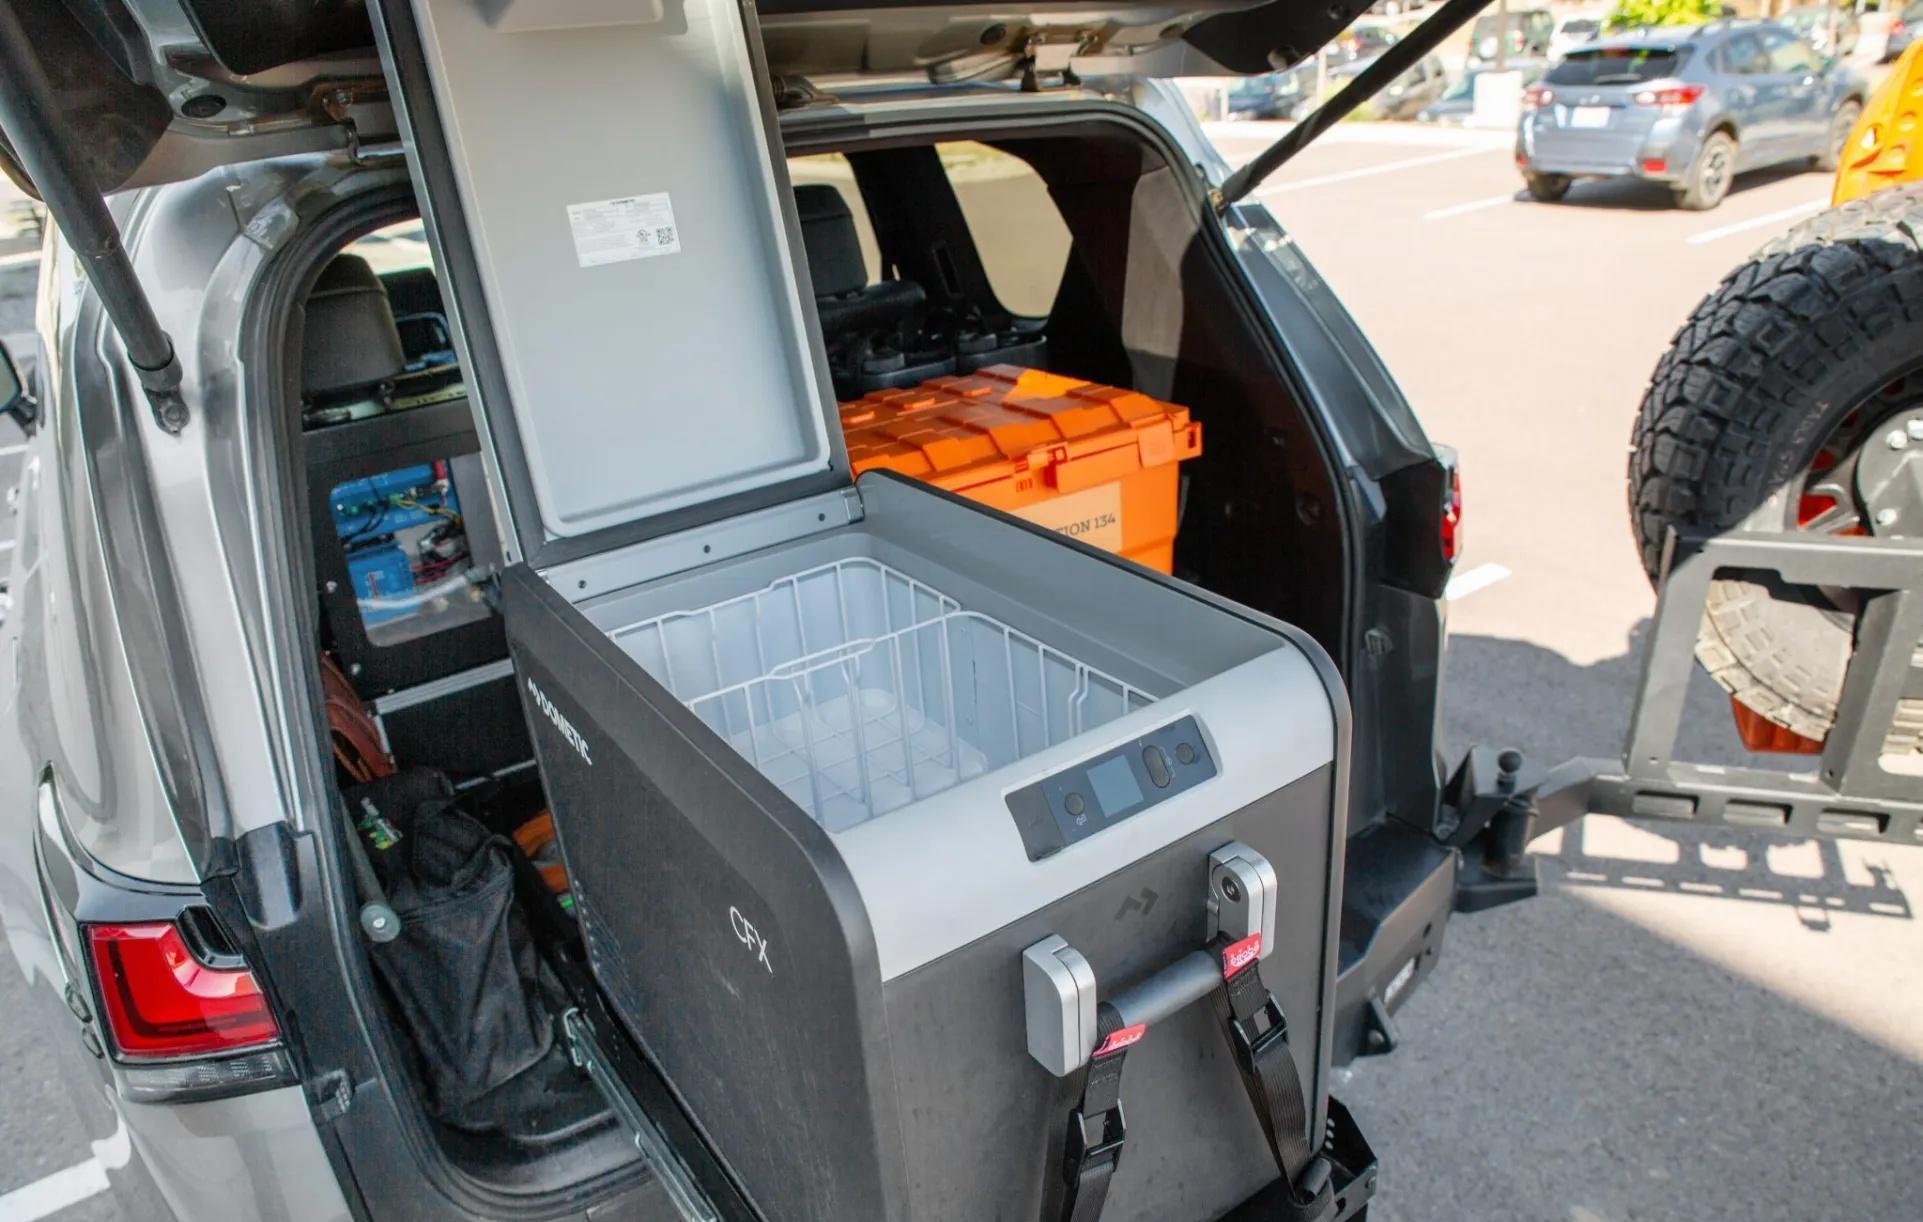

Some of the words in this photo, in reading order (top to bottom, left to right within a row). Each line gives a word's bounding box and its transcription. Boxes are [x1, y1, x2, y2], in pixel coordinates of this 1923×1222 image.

[1094, 512, 1116, 529] 134
[539, 689, 593, 766] DOMETIC
[729, 905, 773, 975] CFX
